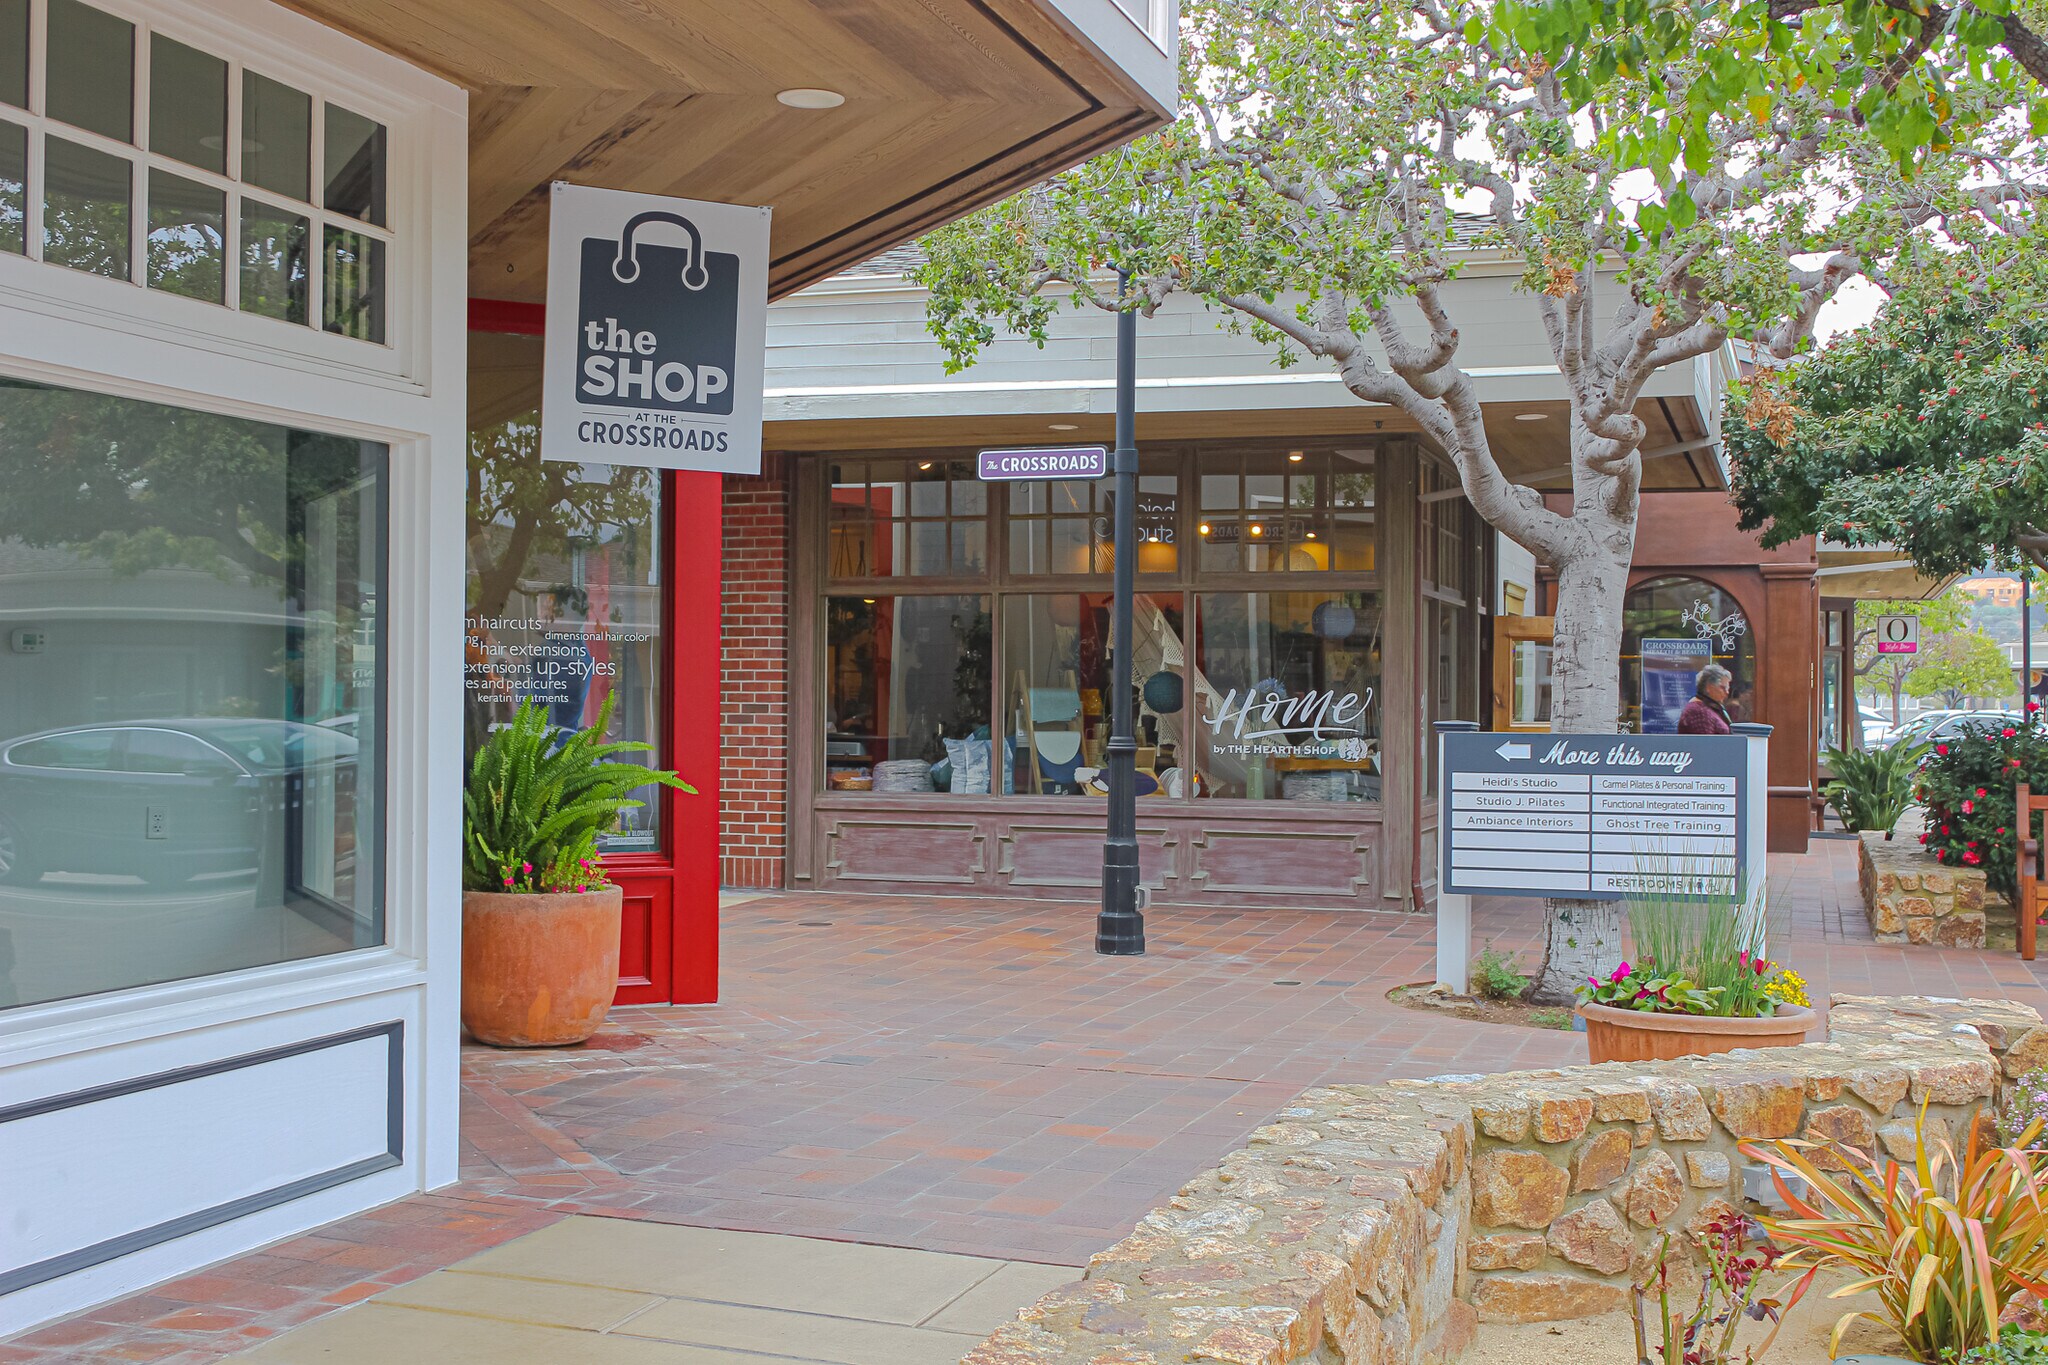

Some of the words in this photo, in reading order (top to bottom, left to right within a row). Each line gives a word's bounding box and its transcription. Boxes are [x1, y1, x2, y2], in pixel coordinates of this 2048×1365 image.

[584, 317, 657, 355] the
[581, 355, 728, 404] SHOP
[635, 412, 650, 423] AT
[654, 414, 676, 425] THE
[577, 421, 728, 452] CROSSROADS
[985, 460, 998, 470] The
[1001, 455, 1098, 472] CROSSROADS
[480, 614, 542, 630] haircuts
[544, 630, 604, 641] dimensional
[605, 631, 623, 641] hair
[624, 632, 650, 642] color
[1886, 618, 1909, 642] O
[480, 641, 507, 656] hair
[509, 642, 587, 657] extensions
[1645, 642, 1709, 650] CROSSROADS
[464, 660, 532, 674] extensions
[537, 657, 616, 681] up-styles
[481, 677, 505, 689] and
[506, 677, 567, 692] pedicures
[477, 693, 512, 703] keratin
[1203, 687, 1373, 741] Home
[1213, 744, 1226, 755] by
[1228, 745, 1251, 754] THE
[1253, 745, 1301, 755] HEARTH
[1302, 745, 1336, 755] SHOP
[1539, 740, 1600, 766] More
[1605, 743, 1645, 766] this
[1649, 751, 1693, 773] way
[1482, 778, 1519, 787] Heidi's
[1521, 778, 1558, 788] Studio
[1602, 779, 1629, 789] Carmel
[1629, 780, 1654, 789] Pilates
[1655, 780, 1660, 789] &
[1662, 781, 1694, 790] Personal
[1695, 781, 1726, 792] Training
[1476, 797, 1512, 806] Studio
[1515, 797, 1525, 806] J.
[1528, 798, 1566, 807] Pilates
[1602, 799, 1645, 809] Functional
[1646, 801, 1690, 811] Integrated
[1691, 801, 1726, 812] Training
[1467, 816, 1523, 825] Ambiance
[1526, 817, 1574, 827] Interiors
[1606, 819, 1640, 829] Ghost
[1644, 820, 1670, 829] Tree
[1674, 821, 1722, 832] Training
